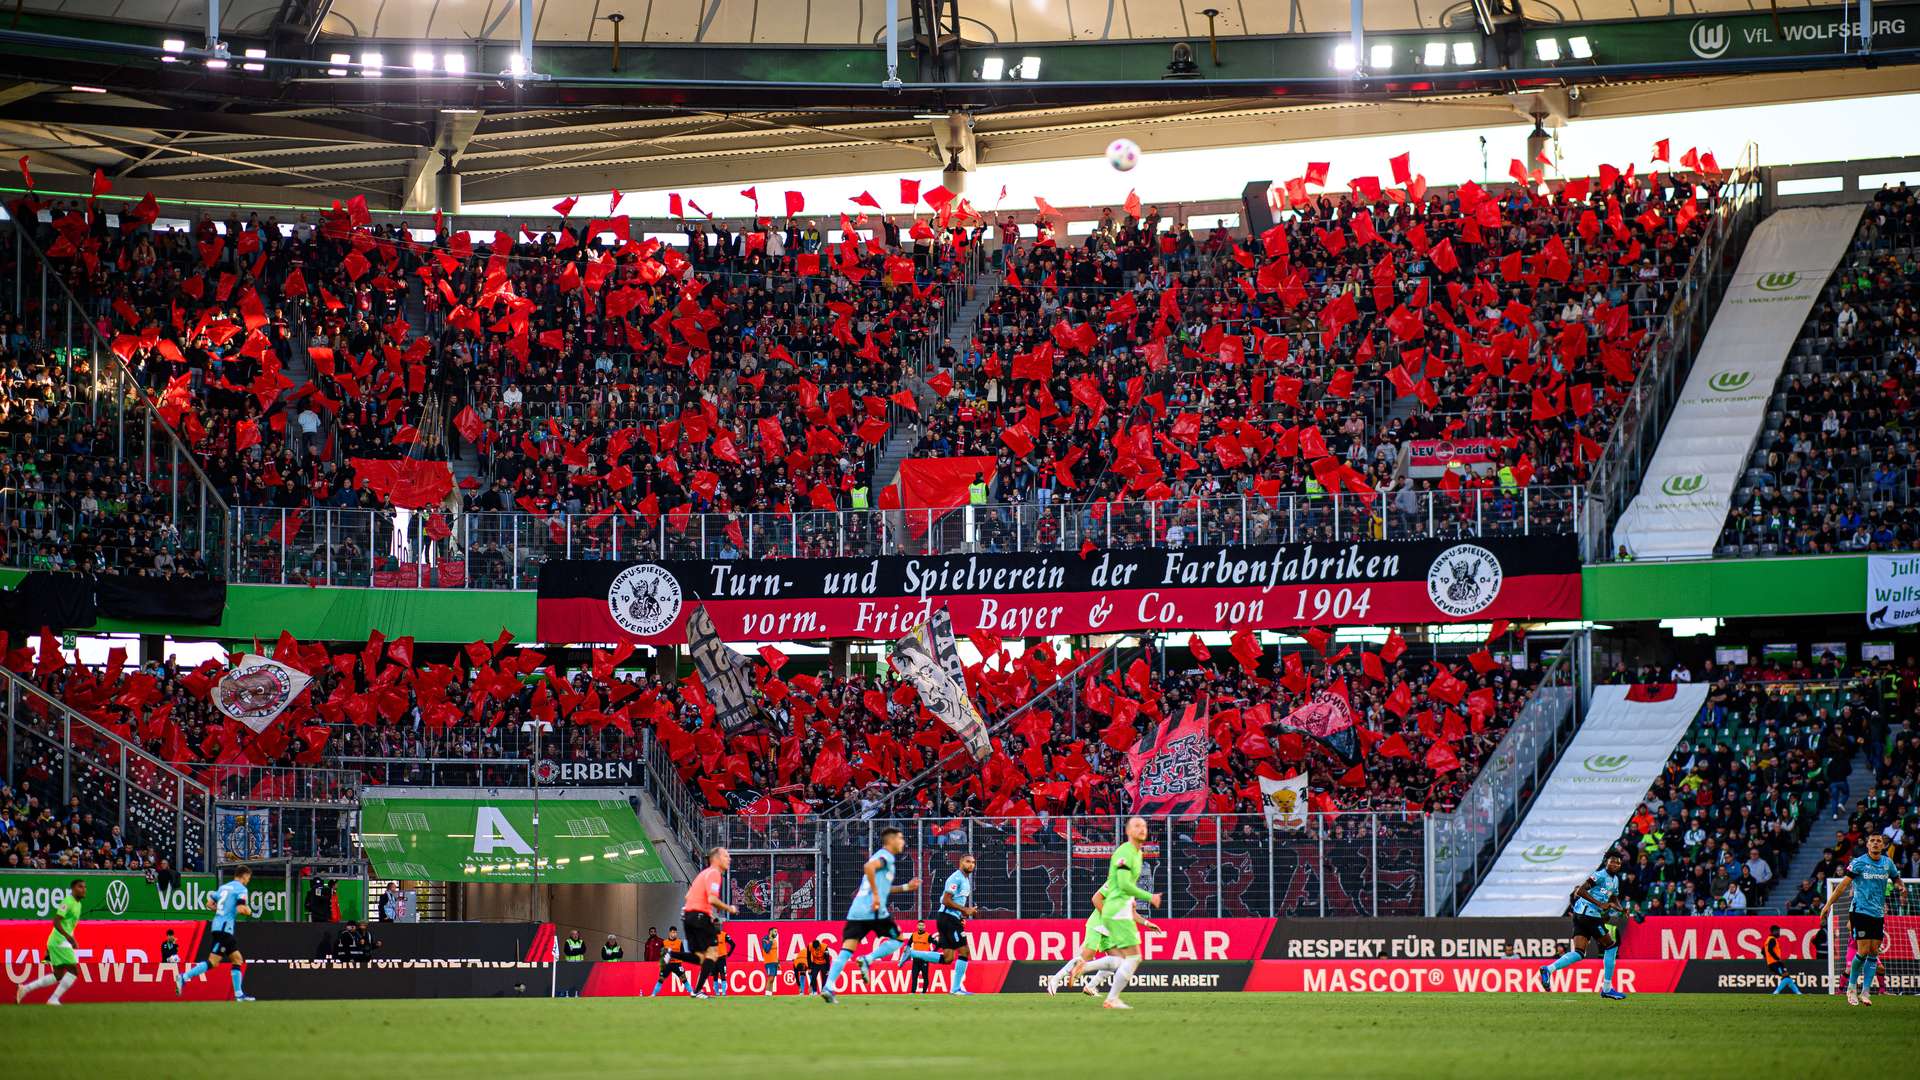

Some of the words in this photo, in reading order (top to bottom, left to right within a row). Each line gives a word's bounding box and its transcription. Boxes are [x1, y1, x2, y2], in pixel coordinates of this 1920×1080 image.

[1744, 28, 1773, 44] VfL
[1411, 446, 1434, 457] LEV
[711, 564, 794, 597] Turn-
[823, 559, 880, 595] und
[903, 556, 1065, 601] Spielverein
[1091, 553, 1138, 587] der
[1161, 544, 1400, 594] Farbenfabriken
[742, 610, 827, 635] vorm.
[976, 598, 1063, 637] Bayer
[1089, 597, 1114, 628] &
[1138, 592, 1184, 624] Co.
[1214, 599, 1265, 624] von
[1293, 588, 1372, 621] 1904
[1433, 595, 1493, 615] LEVERKUSEN
[615, 613, 675, 634] LEVERKUSEN
[63, 634, 76, 646] 29
[561, 761, 633, 780] ERBEN
[473, 806, 536, 854] A
[0, 886, 72, 917] wage
[158, 881, 287, 918] Volksgen
[966, 930, 1231, 960] WOREAR
[1288, 939, 1386, 958] RESPEKT
[1391, 934, 1435, 957] FÜR
[1441, 938, 1506, 957] DEINE
[671, 969, 797, 993] MCOT®
[806, 969, 968, 993] ORKWAR
[1038, 974, 1099, 987] RSPEK
[1130, 974, 1168, 987] DEINE
[1171, 974, 1219, 987] ARBEIT
[1303, 967, 1444, 993] MASCOT®
